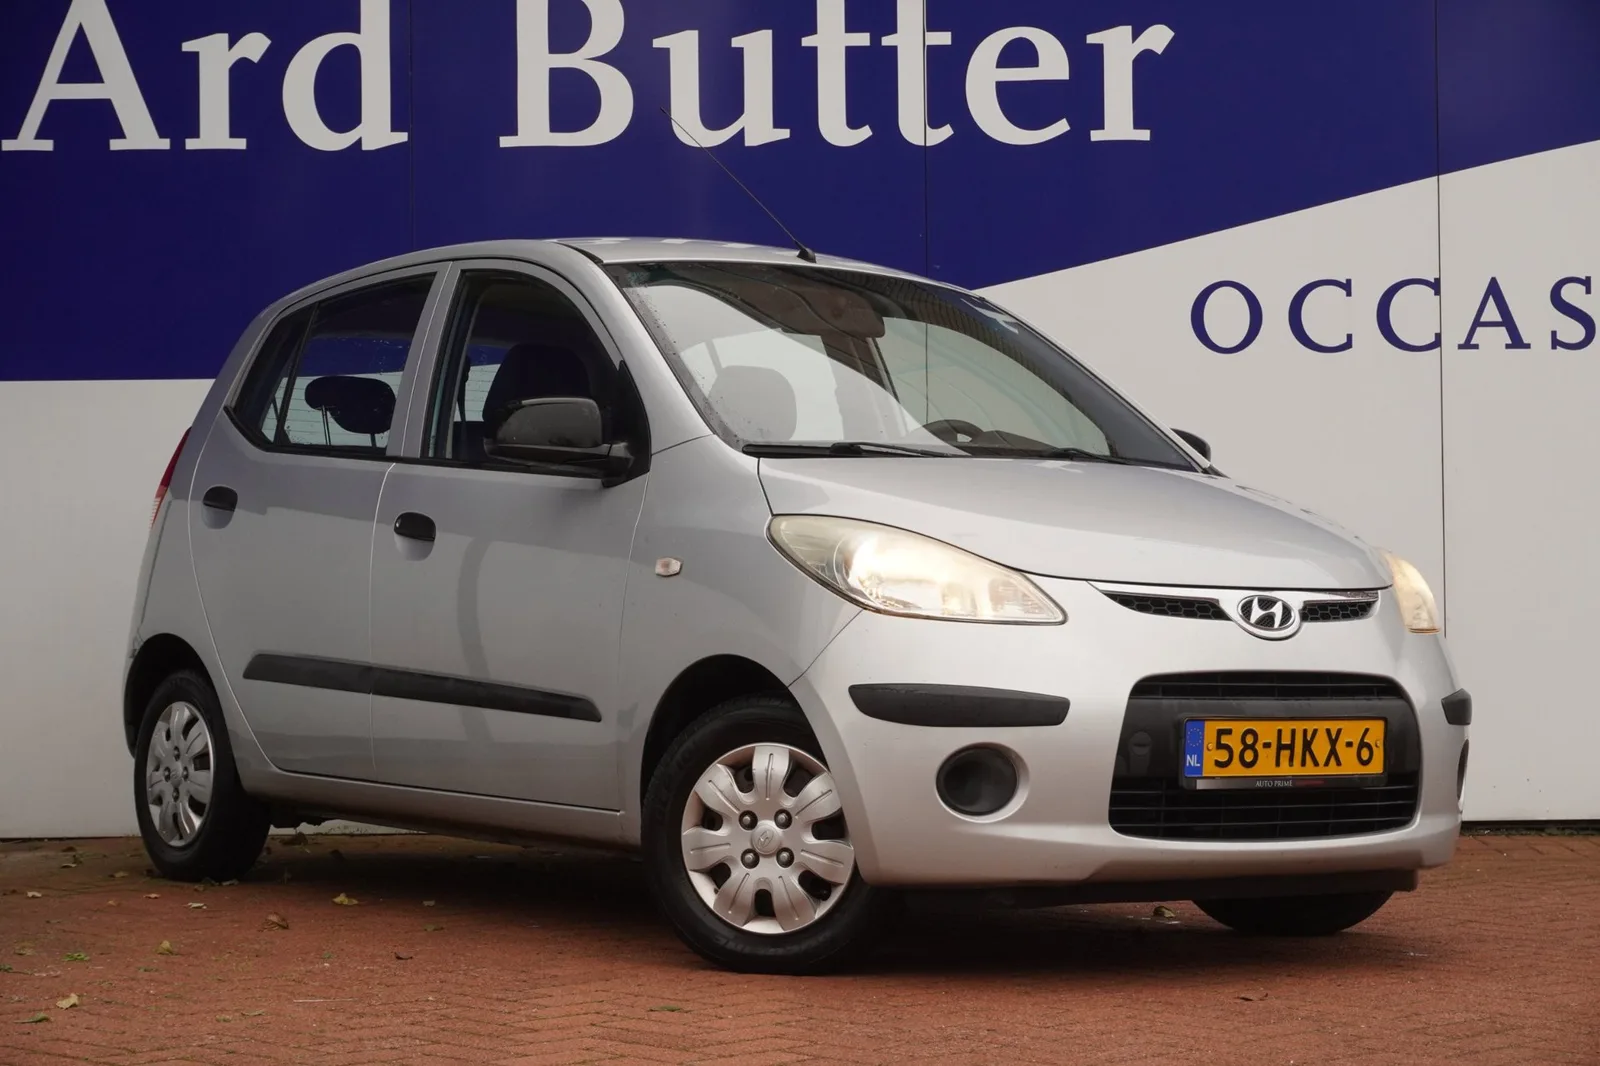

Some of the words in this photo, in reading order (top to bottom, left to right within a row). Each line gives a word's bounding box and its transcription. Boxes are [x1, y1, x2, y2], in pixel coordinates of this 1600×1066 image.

[2, 0, 408, 151] Ard
[500, 0, 1174, 148] Butter
[1190, 276, 1597, 354] OCCAS
[1186, 754, 1201, 767] NL
[1213, 727, 1374, 769] 58-HKX-6
[1274, 779, 1292, 787] PRIME
